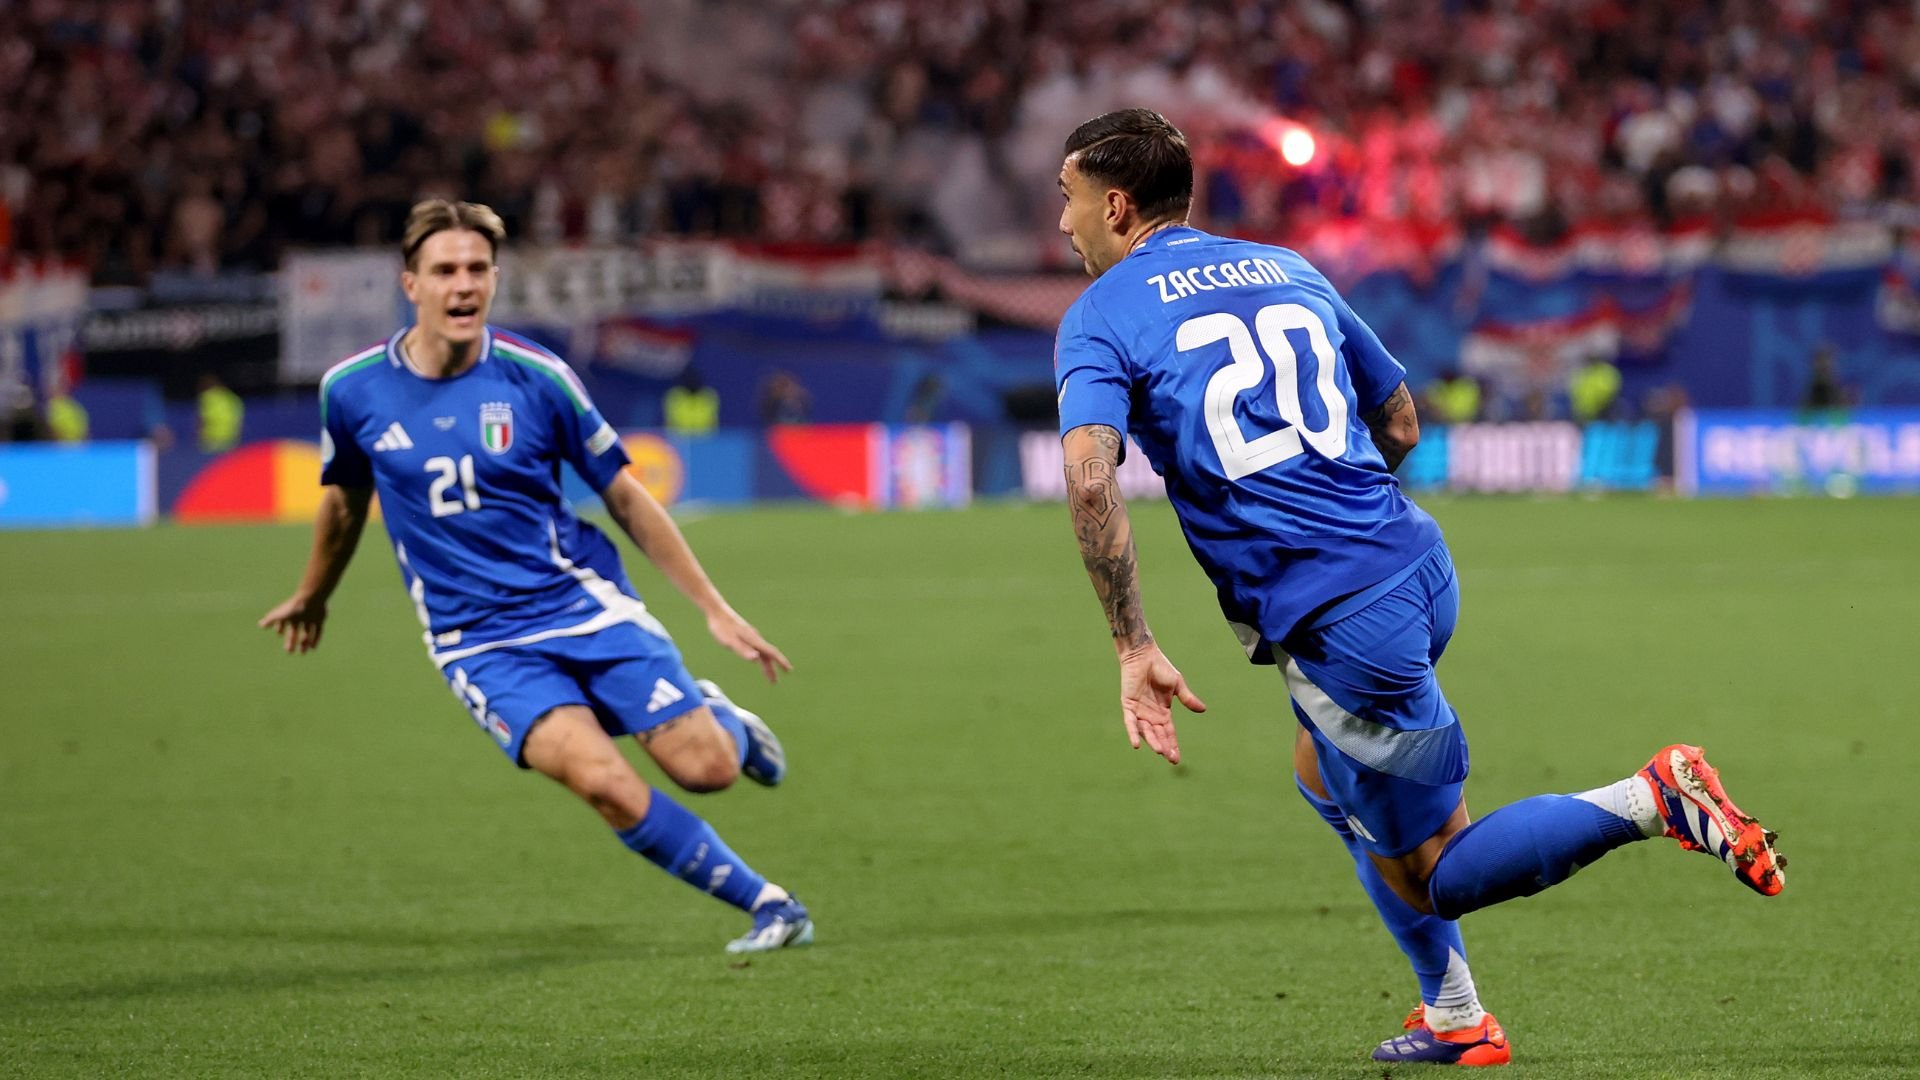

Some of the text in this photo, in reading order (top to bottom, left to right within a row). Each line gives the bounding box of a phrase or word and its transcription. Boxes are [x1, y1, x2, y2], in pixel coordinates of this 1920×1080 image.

[1146, 258, 1290, 304] ZACCAGNI
[1175, 303, 1348, 482] 20
[424, 455, 481, 518] 21
